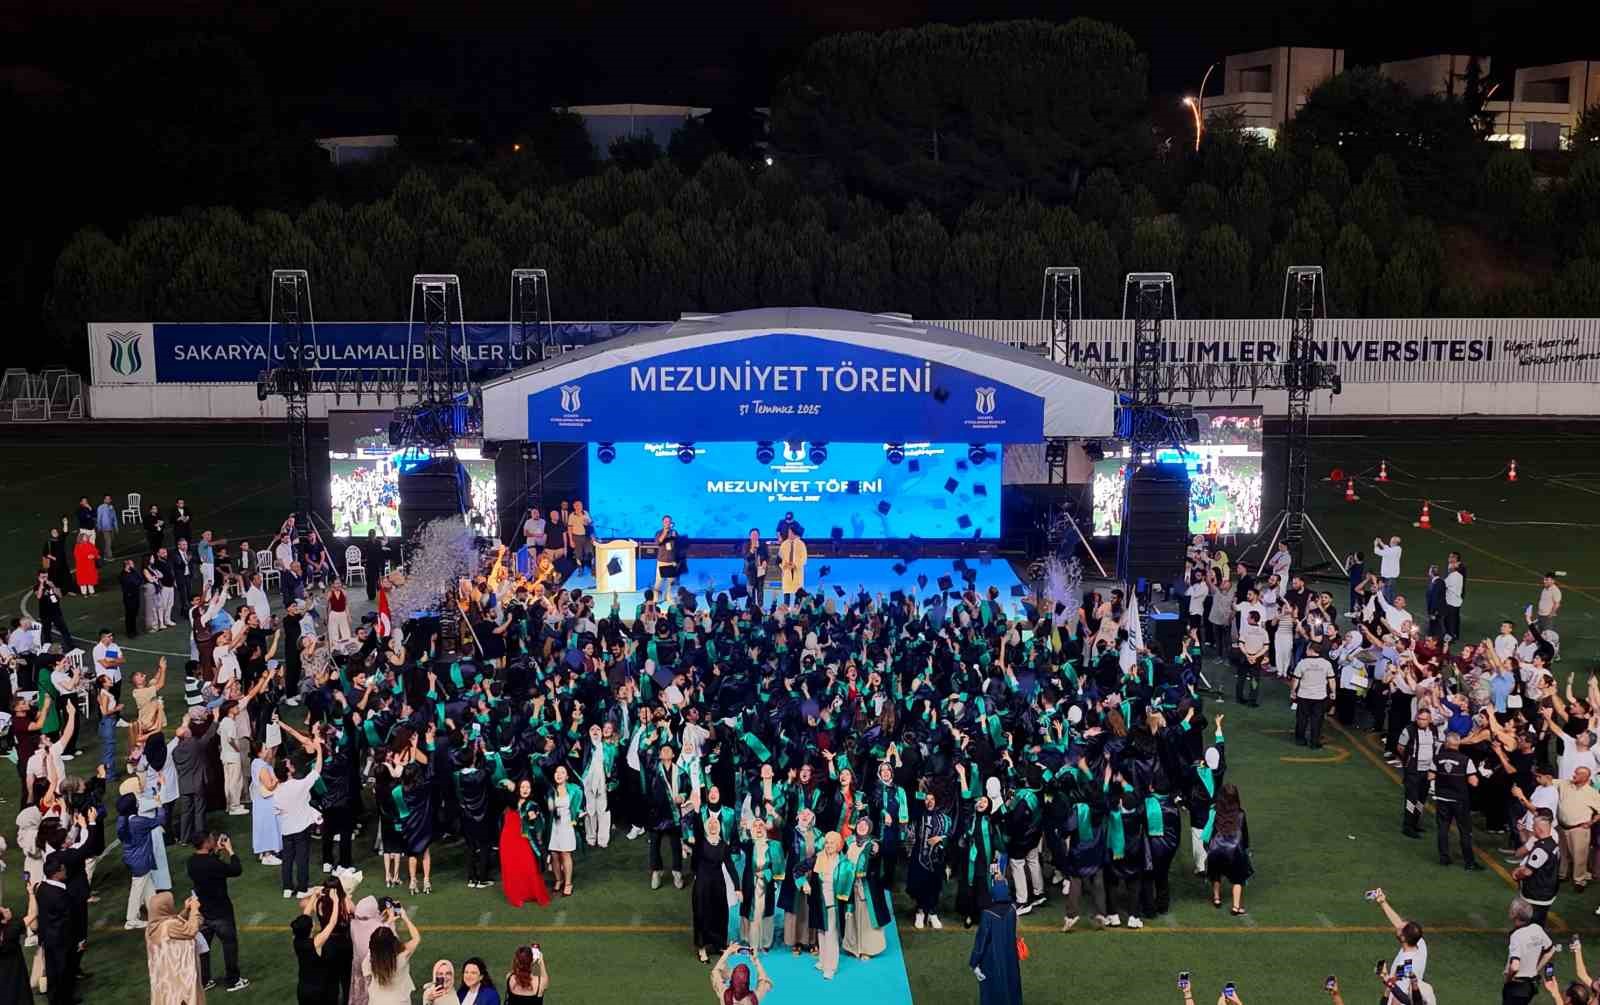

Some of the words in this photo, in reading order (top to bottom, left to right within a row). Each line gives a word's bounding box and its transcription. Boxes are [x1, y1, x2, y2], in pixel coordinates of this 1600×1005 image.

[174, 345, 266, 360] SAKARYA
[273, 344, 404, 360] UYGULAMALI
[412, 344, 504, 360] BİLMLER
[1139, 337, 1277, 362] BİLİMLER
[1289, 336, 1493, 362] ÜNİVERSİTESİ
[630, 361, 808, 392] MEZUNİYET
[815, 361, 932, 393] TÖRENİ
[751, 399, 795, 414] Temmuz
[797, 404, 822, 415] 2025
[707, 479, 810, 493] MEZUNİYET
